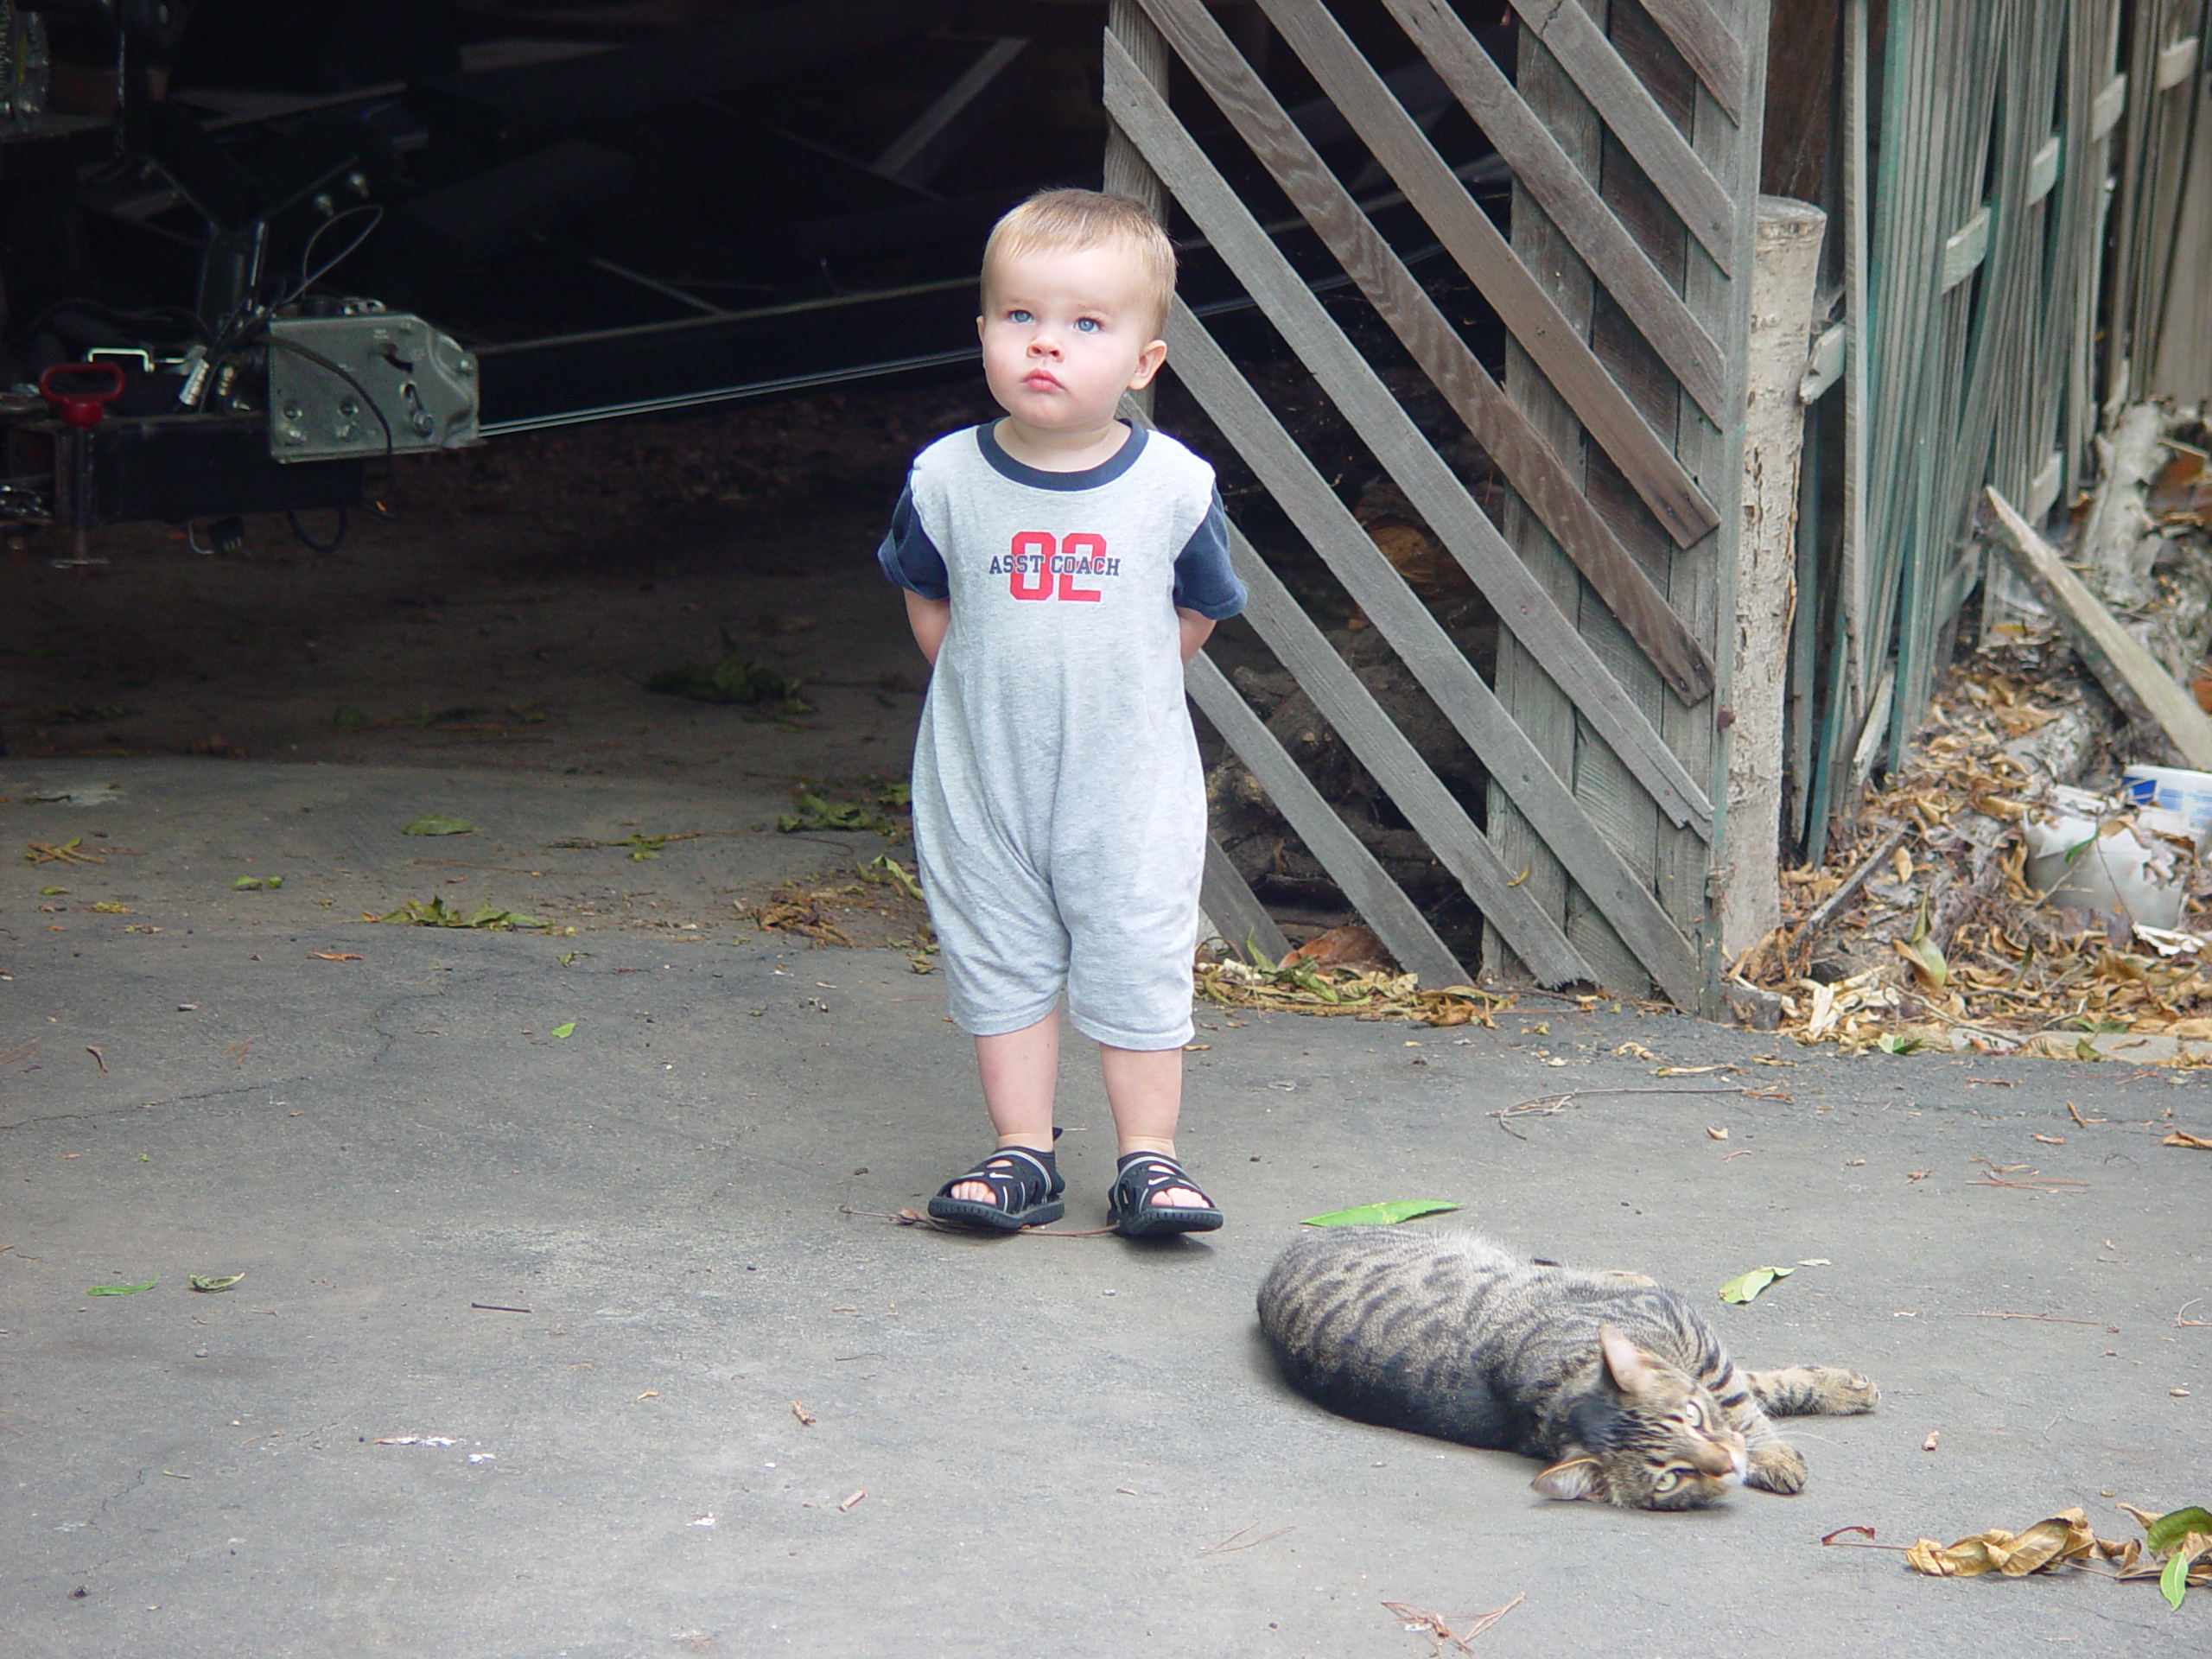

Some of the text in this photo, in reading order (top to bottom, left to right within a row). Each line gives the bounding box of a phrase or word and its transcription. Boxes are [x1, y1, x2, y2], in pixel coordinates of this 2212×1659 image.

[989, 555, 1121, 576] ASST COACH
[1011, 531, 1107, 602] 02
